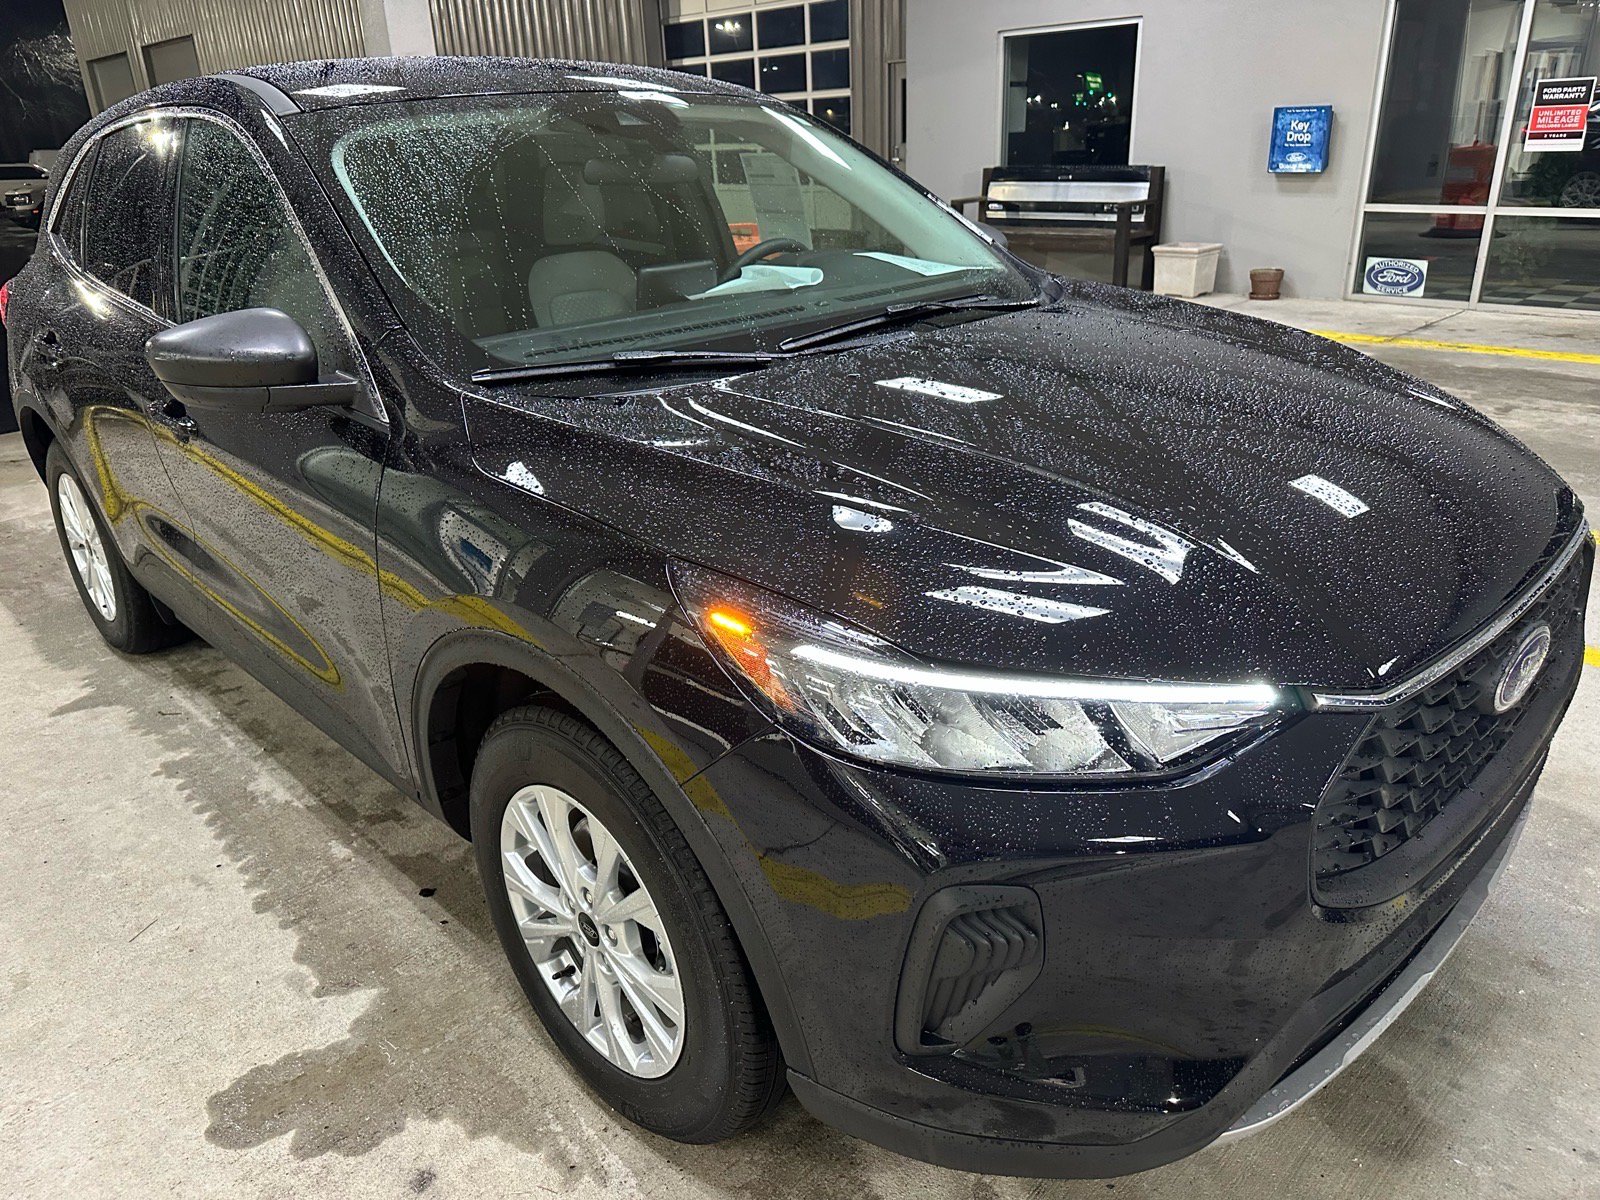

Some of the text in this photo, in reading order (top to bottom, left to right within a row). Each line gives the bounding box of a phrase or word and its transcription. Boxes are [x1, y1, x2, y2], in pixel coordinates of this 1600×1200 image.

[1542, 92, 1585, 100] WARRANTY
[1290, 119, 1310, 132] Key
[1537, 115, 1580, 124] MILEAGE
[1286, 131, 1312, 143] Drop
[1374, 260, 1420, 273] AUTHORIZED
[1377, 269, 1412, 283] Ford
[1376, 285, 1408, 294] SERVICE
